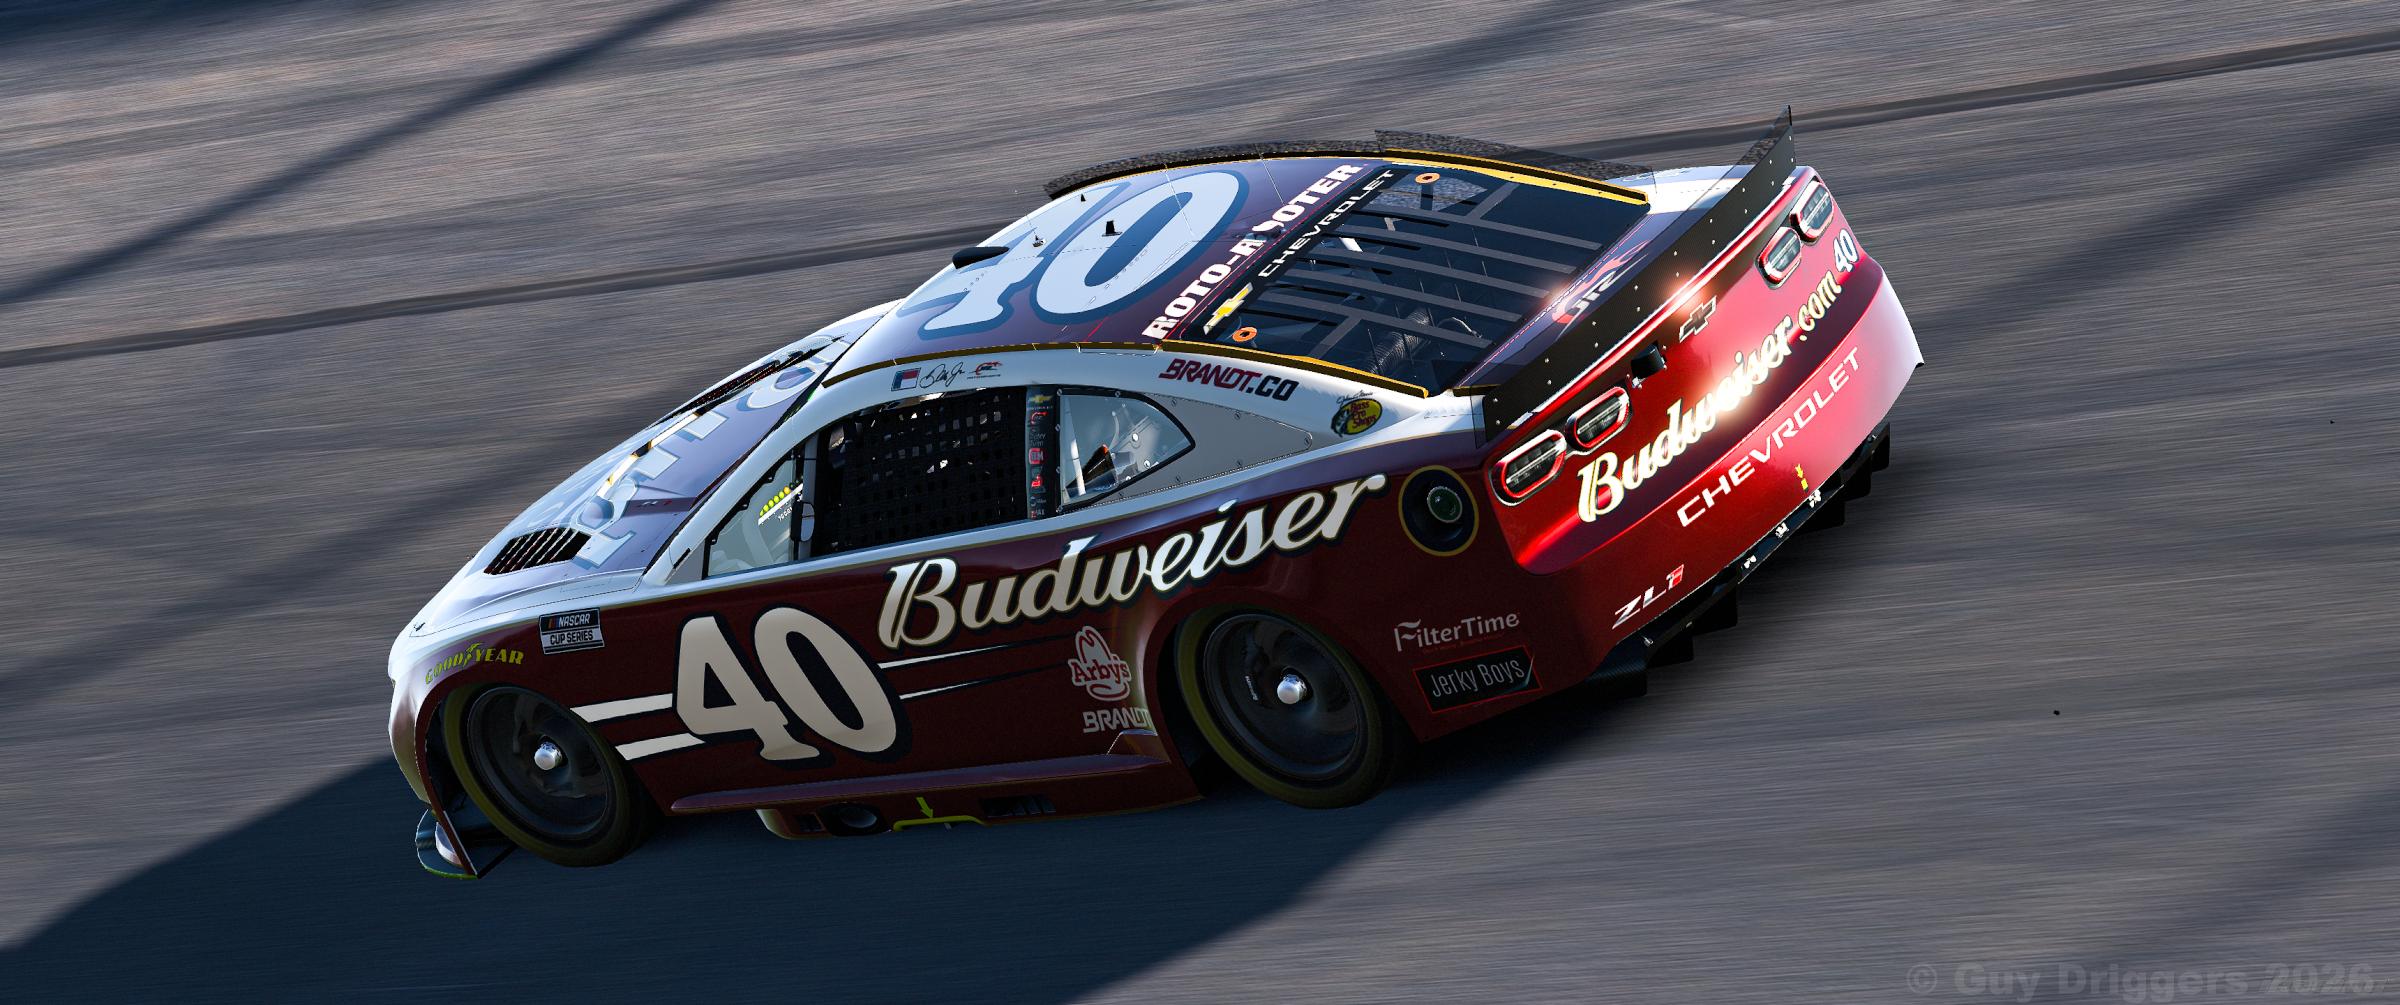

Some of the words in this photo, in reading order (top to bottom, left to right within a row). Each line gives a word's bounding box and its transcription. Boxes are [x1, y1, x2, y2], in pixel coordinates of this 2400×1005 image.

[1258, 169, 1394, 277] CHEVROLET
[897, 170, 1242, 334] 40
[1833, 228, 1859, 272] 40
[1158, 358, 1300, 402] BRANDT.CO
[1677, 346, 1860, 527] CHEVROLET
[878, 474, 1386, 649] Budweiser
[550, 633, 565, 645] CUP
[567, 630, 594, 643] SERIES
[558, 613, 591, 628] NASCAR
[1394, 612, 1521, 652] FilterTime
[425, 643, 525, 685] GOODYEAR
[676, 606, 898, 761] 40
[1070, 654, 1131, 684] Arby's
[1430, 669, 1478, 698] Jerky
[1477, 659, 1525, 686] Boys
